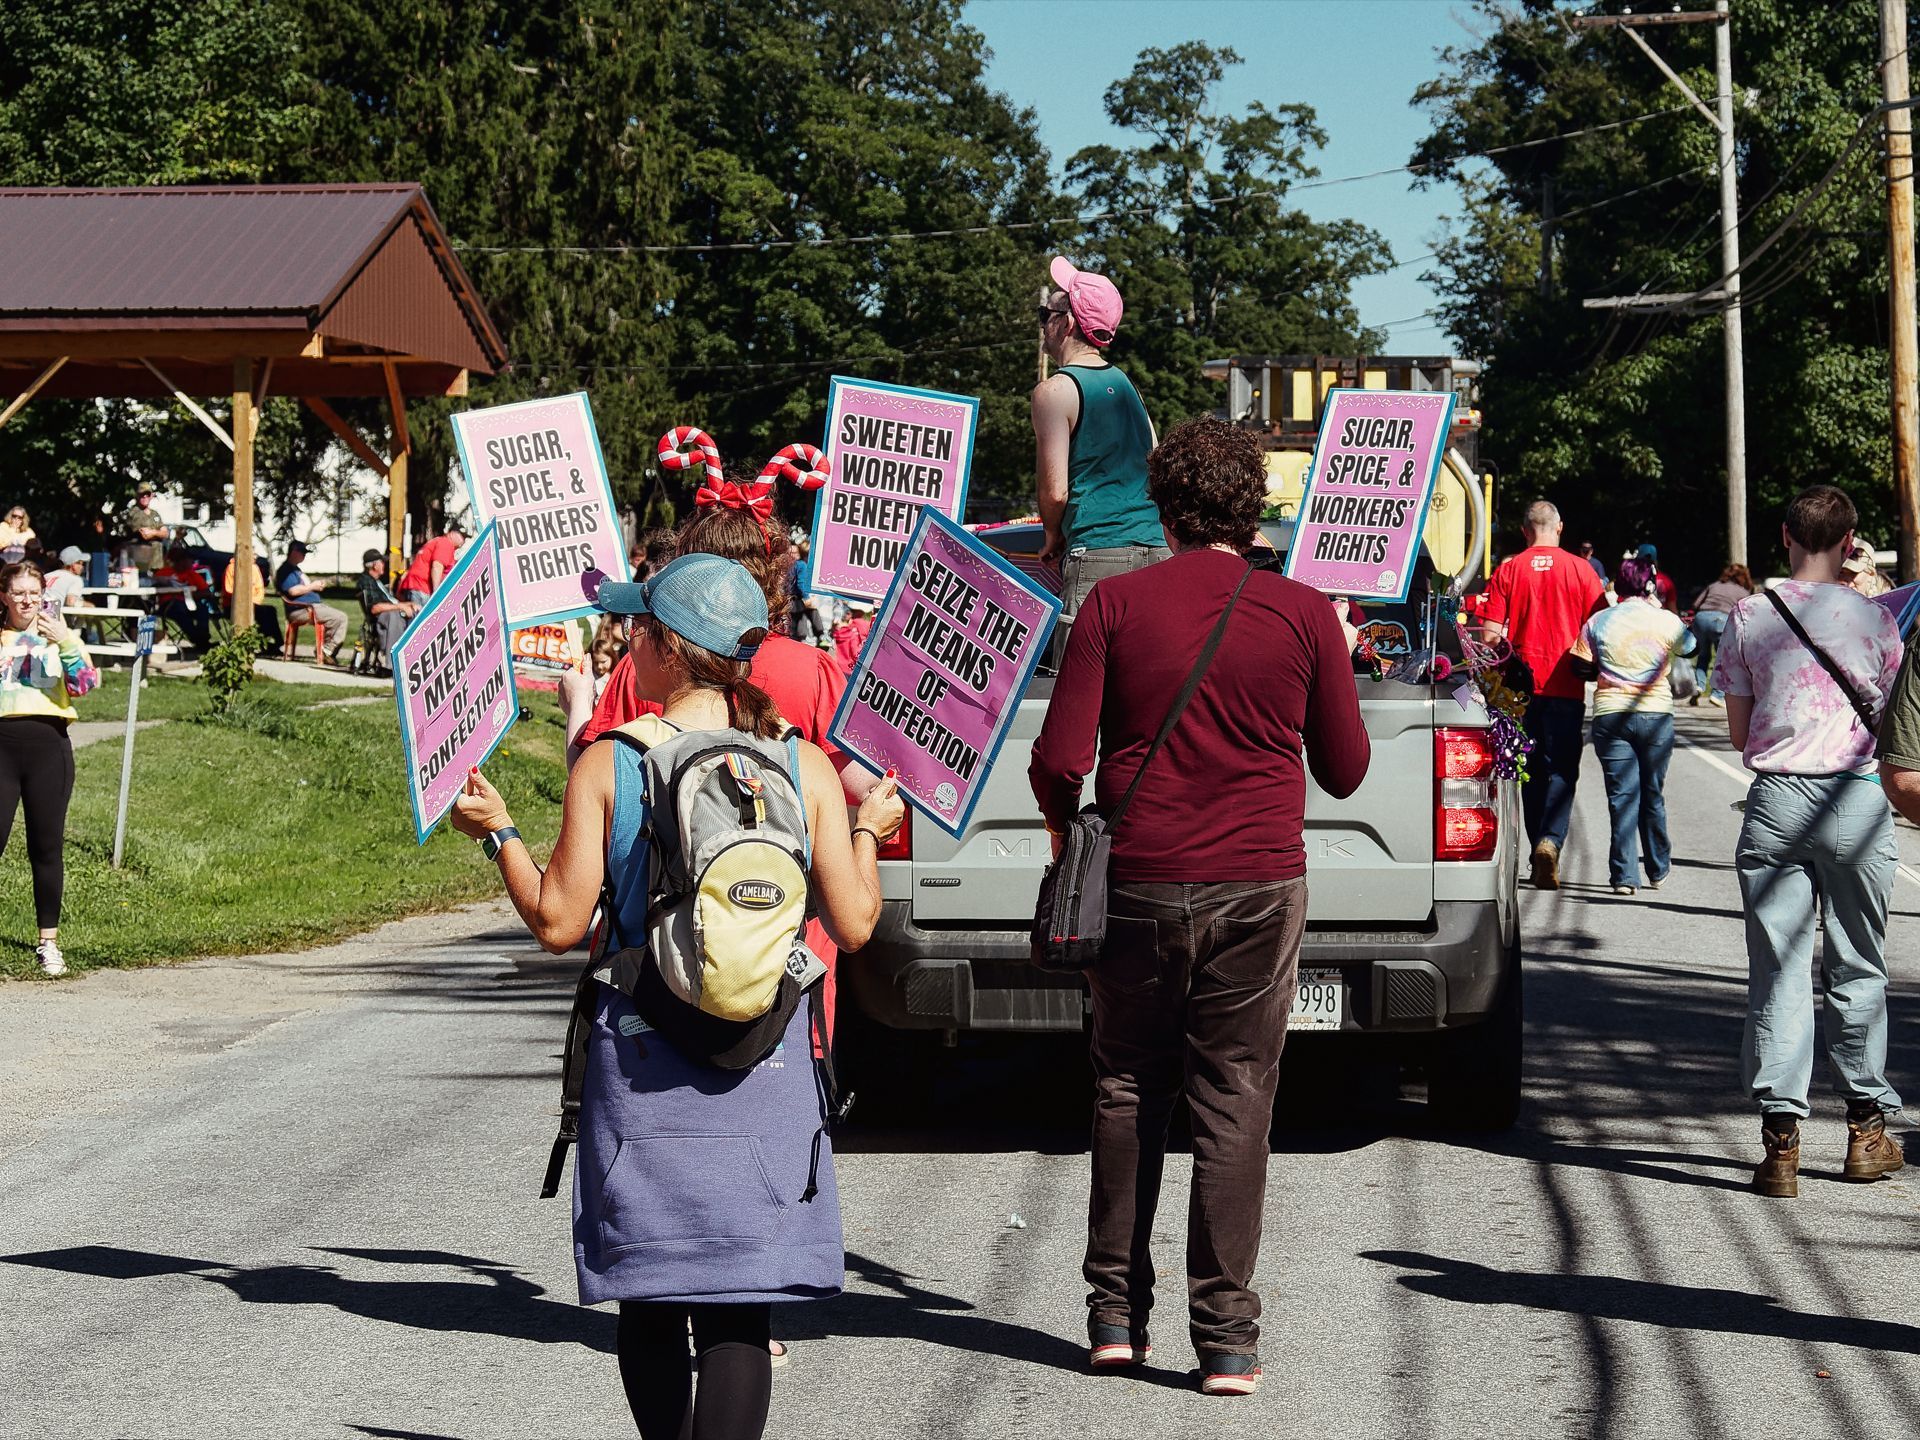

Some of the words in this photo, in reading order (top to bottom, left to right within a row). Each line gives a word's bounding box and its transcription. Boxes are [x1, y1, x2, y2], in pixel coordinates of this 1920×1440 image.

[486, 429, 571, 470] SUGAR,
[841, 414, 953, 461] SWEETEN
[1341, 418, 1415, 454] SUGAR,
[489, 470, 564, 509] SPICE,
[570, 468, 587, 495] &
[842, 453, 943, 499] WORKER
[1326, 455, 1390, 489] SPICE,
[1398, 460, 1415, 487] &
[831, 491, 923, 535] BENEFI
[1309, 495, 1415, 528] WORKERS'
[517, 542, 596, 584] RIGHTS
[1313, 532, 1389, 564] RIGHTS
[909, 552, 980, 627] SEIZE
[977, 600, 1029, 663] THE
[408, 616, 458, 695] SEIZE
[461, 569, 490, 623] THE
[904, 607, 995, 692] MEANS
[423, 616, 486, 716] MEANS
[451, 682, 470, 719] OF
[916, 669, 949, 709] OF
[419, 664, 504, 791] CONFECTION
[858, 671, 979, 781] CONFECTION
[736, 885, 776, 903] CAMELBAK
